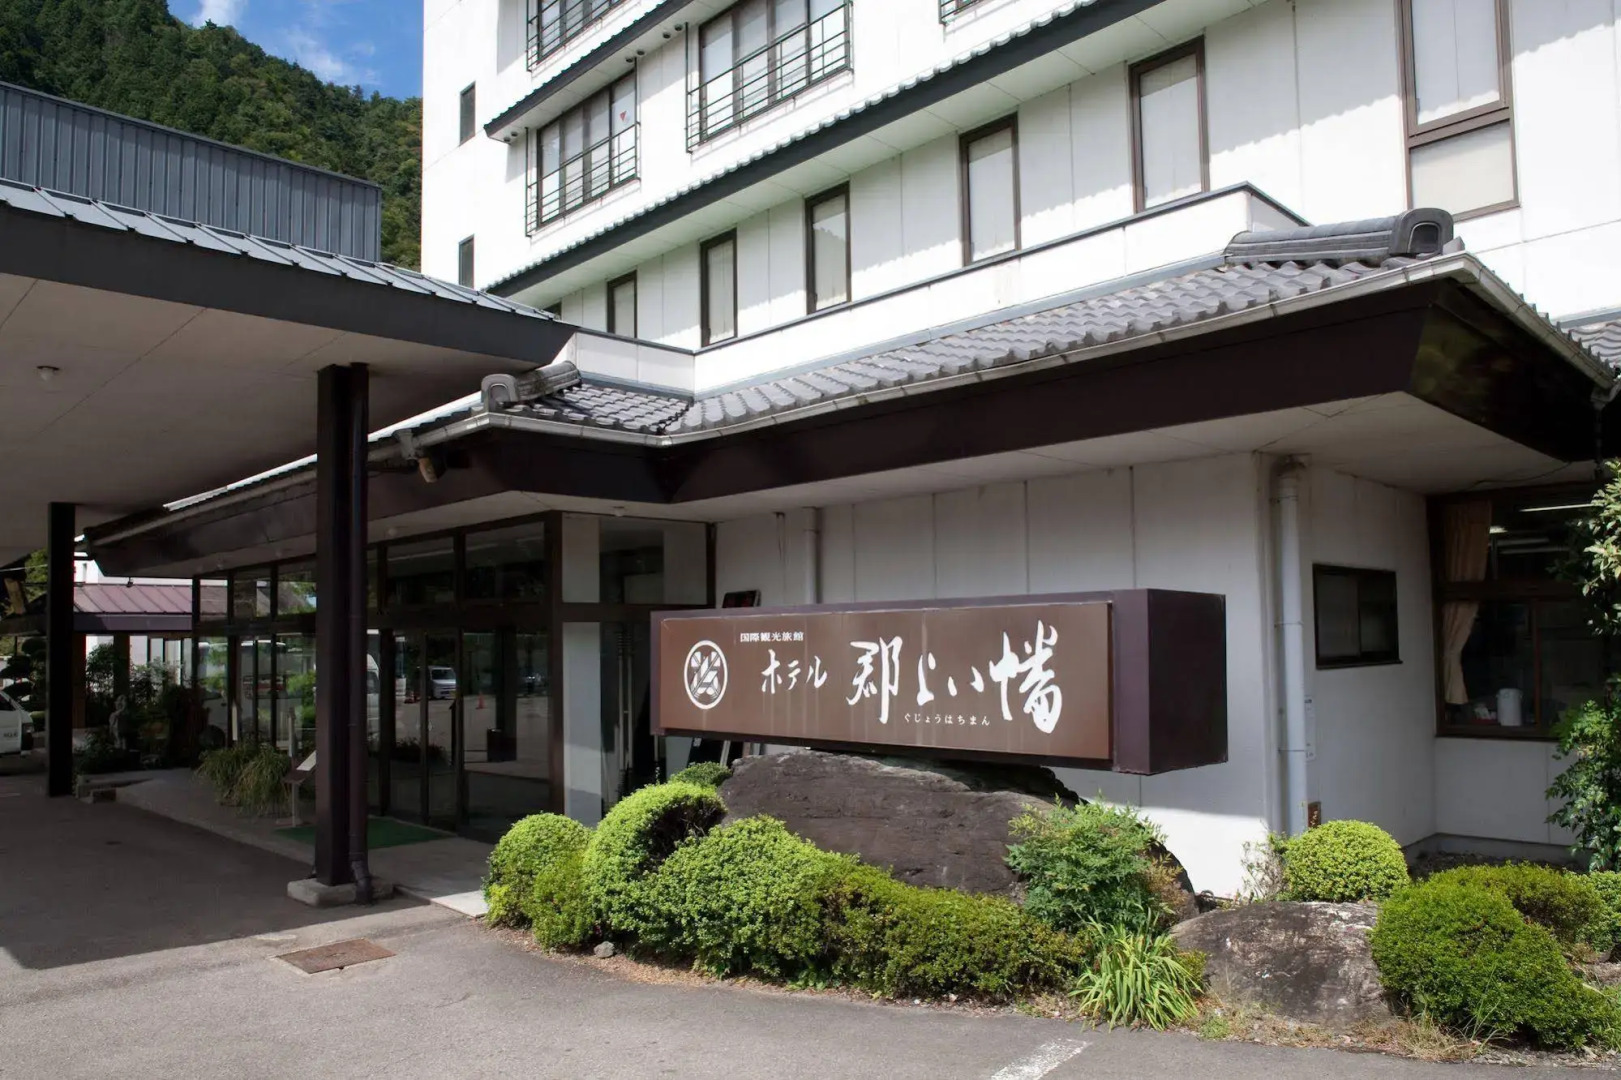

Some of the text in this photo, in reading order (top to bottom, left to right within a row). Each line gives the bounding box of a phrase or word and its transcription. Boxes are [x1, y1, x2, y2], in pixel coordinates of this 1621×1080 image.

[740, 631, 804, 643] 国際観光旅館
[761, 648, 828, 695] ホテル
[904, 712, 990, 726] ぐじょうはちまん
